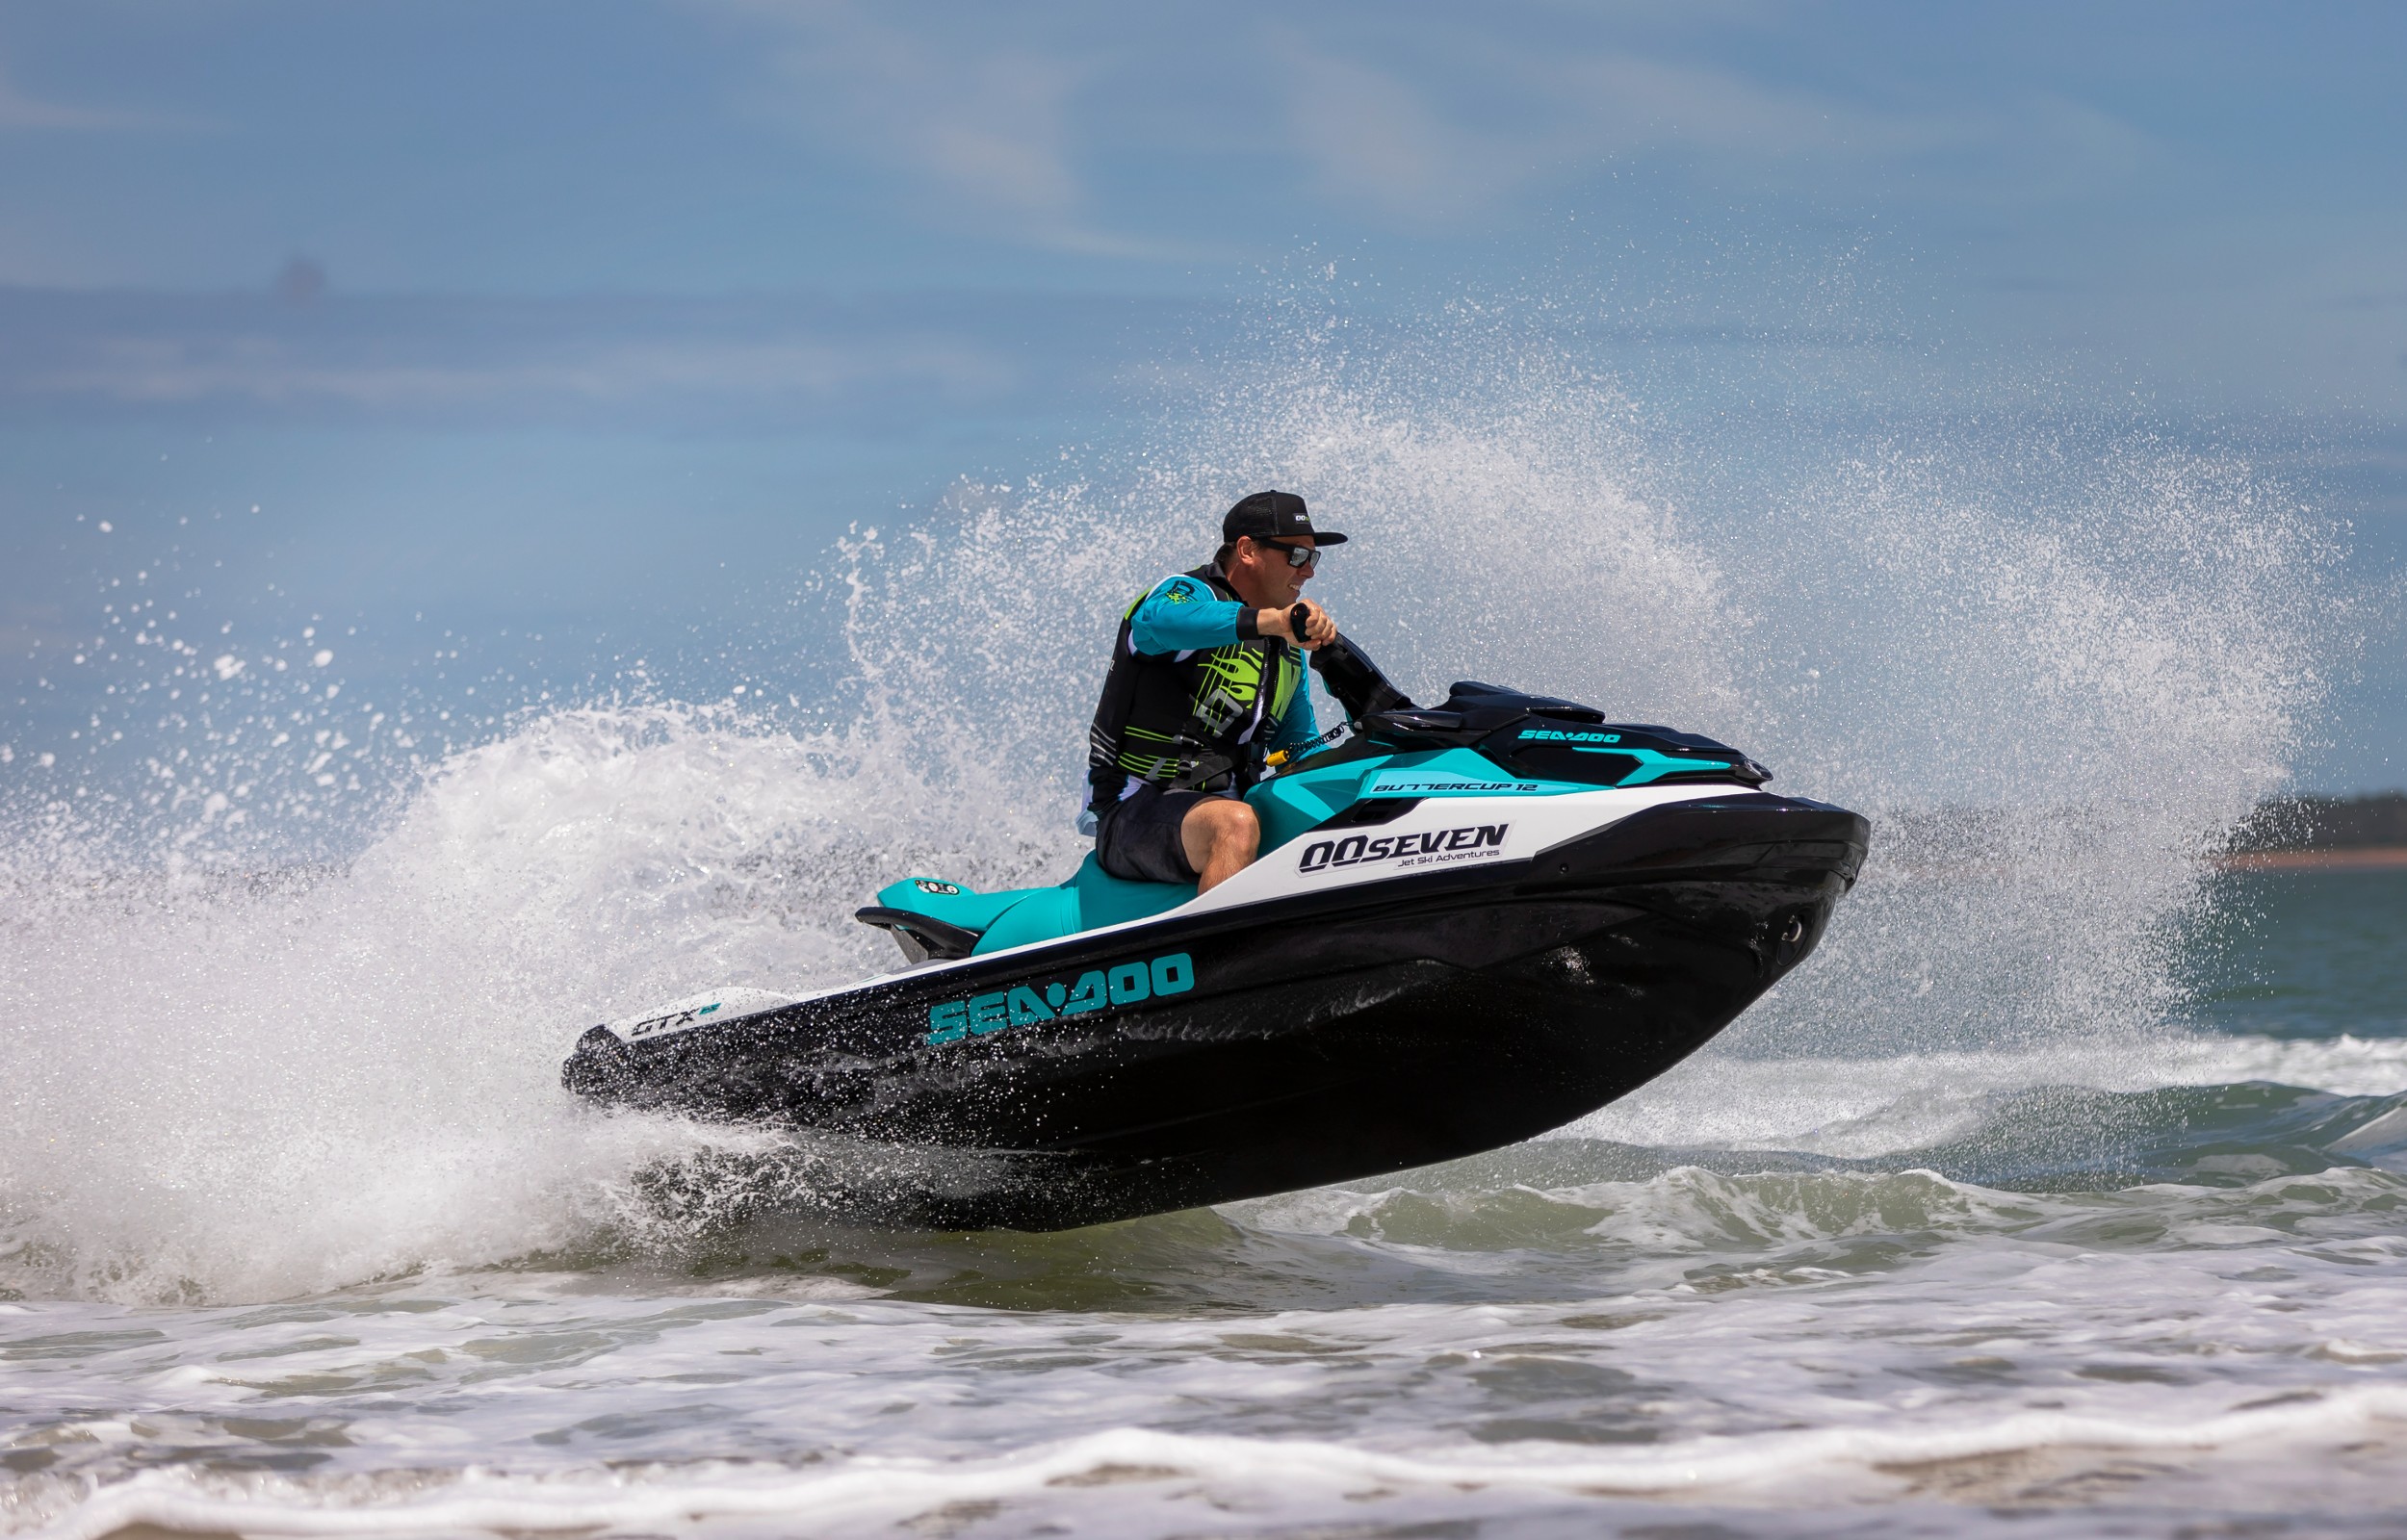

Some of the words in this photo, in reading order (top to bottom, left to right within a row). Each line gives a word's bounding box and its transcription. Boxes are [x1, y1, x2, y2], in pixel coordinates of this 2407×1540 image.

[1372, 783, 1513, 792] BUTTERCUP
[1397, 859, 1414, 867] Jet
[1417, 856, 1434, 864] Ski
[1436, 849, 1500, 862] Adventures
[632, 1007, 700, 1036] GTX
